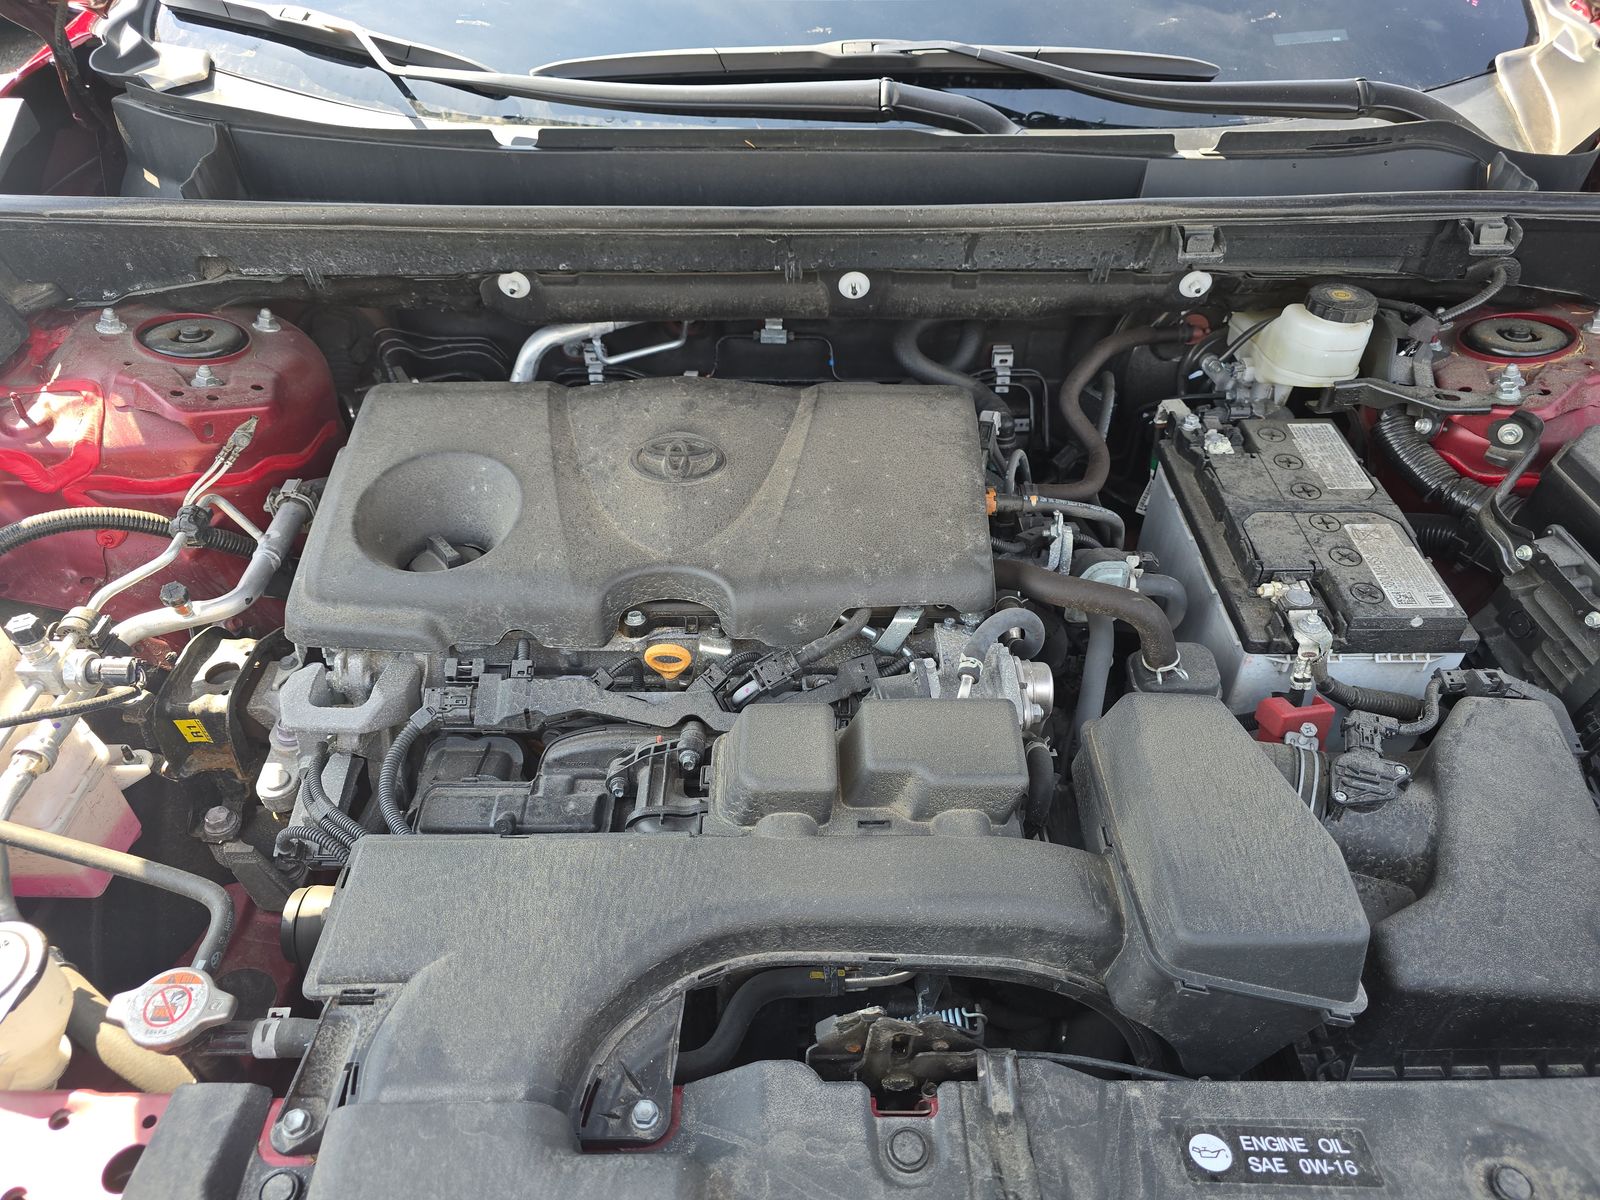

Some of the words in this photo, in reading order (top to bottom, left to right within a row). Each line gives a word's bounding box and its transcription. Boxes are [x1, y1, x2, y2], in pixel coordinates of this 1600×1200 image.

[1239, 1135, 1308, 1153] ENGINE
[1318, 1138, 1350, 1154] OIL
[1248, 1156, 1288, 1174] SAE
[1299, 1158, 1358, 1176] 0W-16
